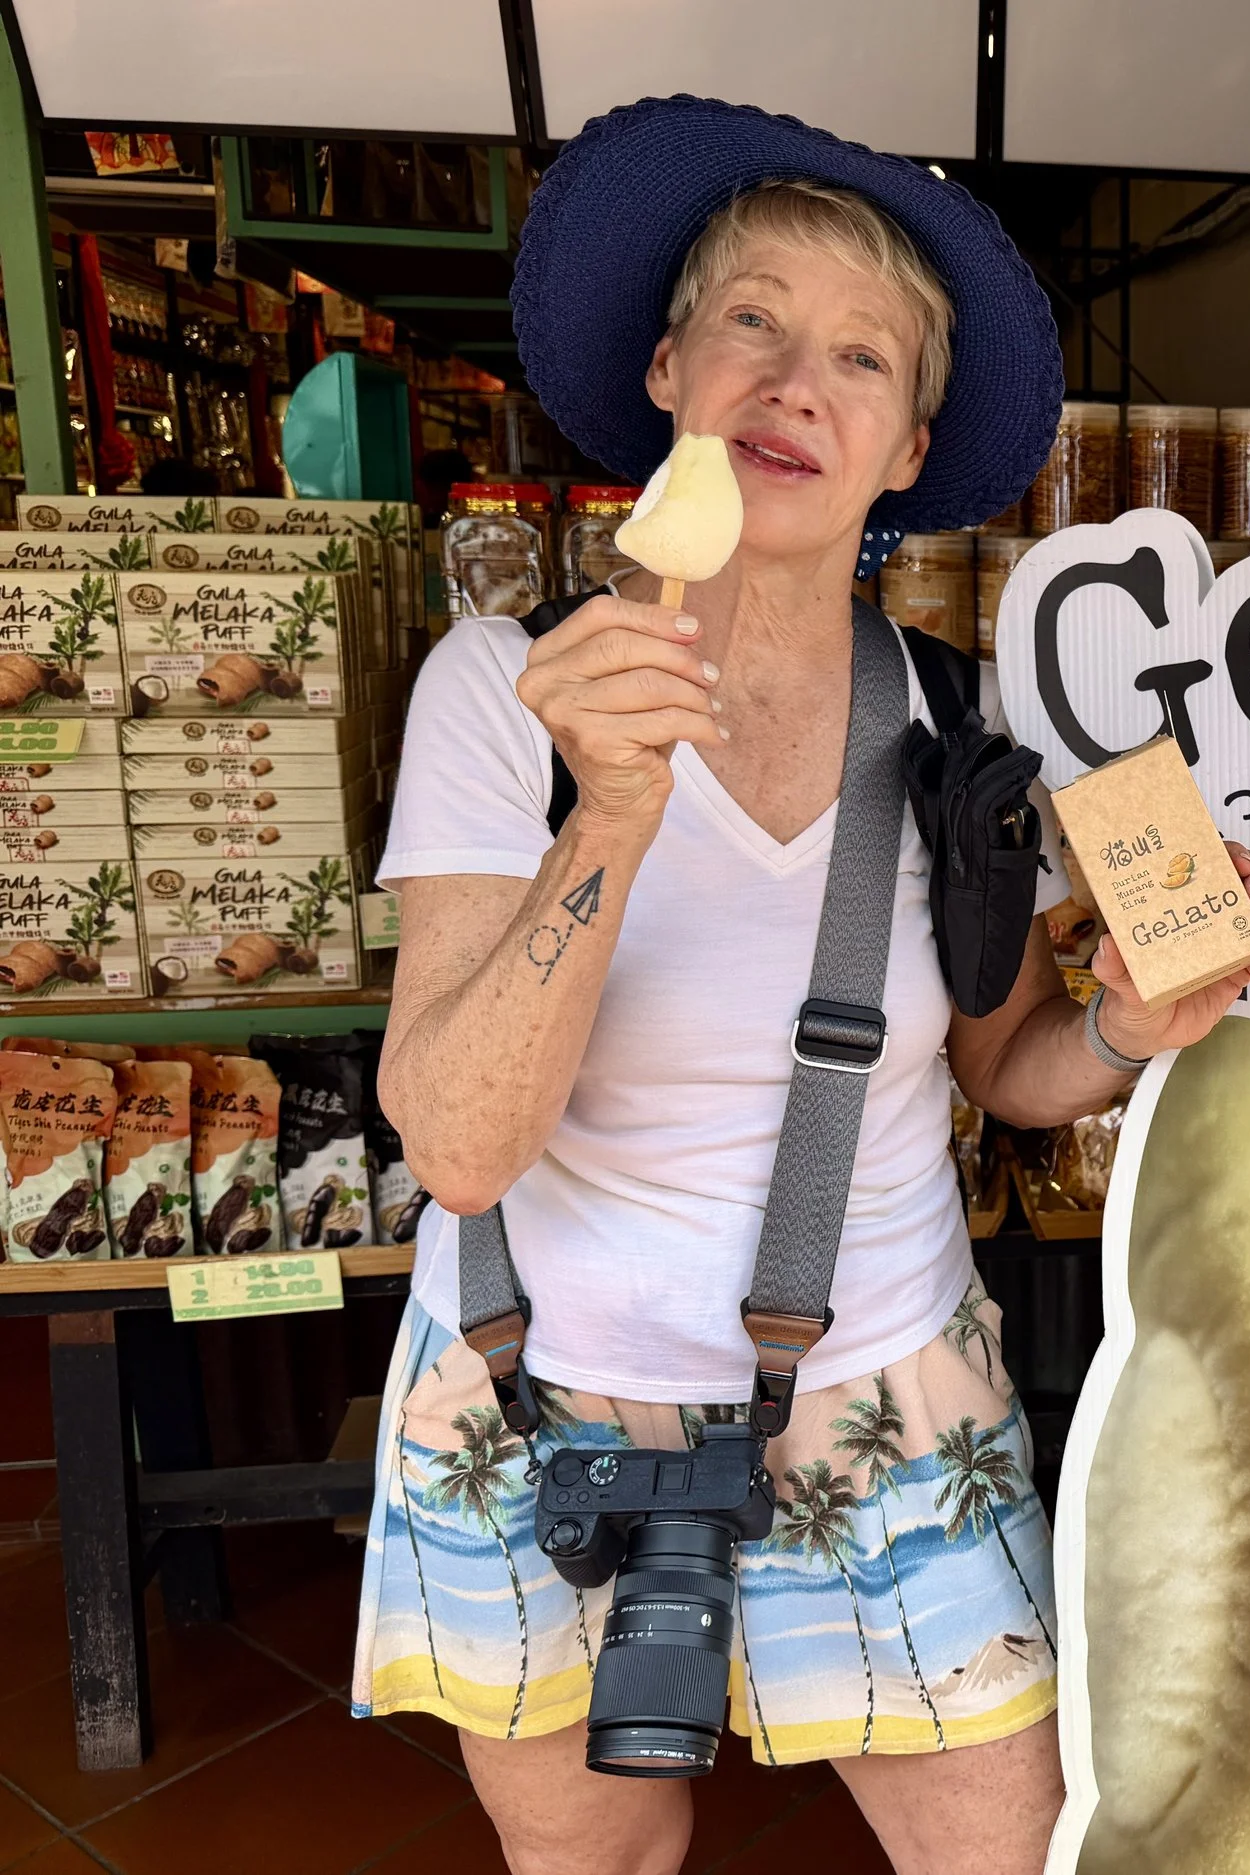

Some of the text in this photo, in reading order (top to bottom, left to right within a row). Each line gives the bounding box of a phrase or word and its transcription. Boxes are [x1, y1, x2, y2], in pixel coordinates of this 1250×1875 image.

[88, 505, 134, 521] GULA
[286, 507, 330, 523] GULA
[15, 542, 64, 559] GULA
[227, 544, 275, 561] GULA
[197, 584, 247, 601] GULA
[0, 601, 54, 623] AKA
[172, 599, 276, 624] MELAKA
[0, 625, 32, 640] FF
[201, 623, 254, 641] PUFF
[214, 867, 264, 884] GULA
[1112, 869, 1150, 890] Durian
[191, 886, 293, 907] MELAKA
[1116, 879, 1155, 901] Musang
[0, 890, 71, 911] ELAKA
[383, 898, 396, 912] 1
[1120, 894, 1148, 912] King
[219, 905, 270, 922] PUFF
[1132, 890, 1239, 946] Gelato
[12, 1088, 105, 1117] 虎皮花生
[117, 1093, 174, 1118] 皮花生
[299, 1088, 349, 1116] 皮花生
[8, 1115, 98, 1133] Tiger Skin Peanuts
[191, 1270, 205, 1285] 1
[191, 1289, 208, 1304] 2
